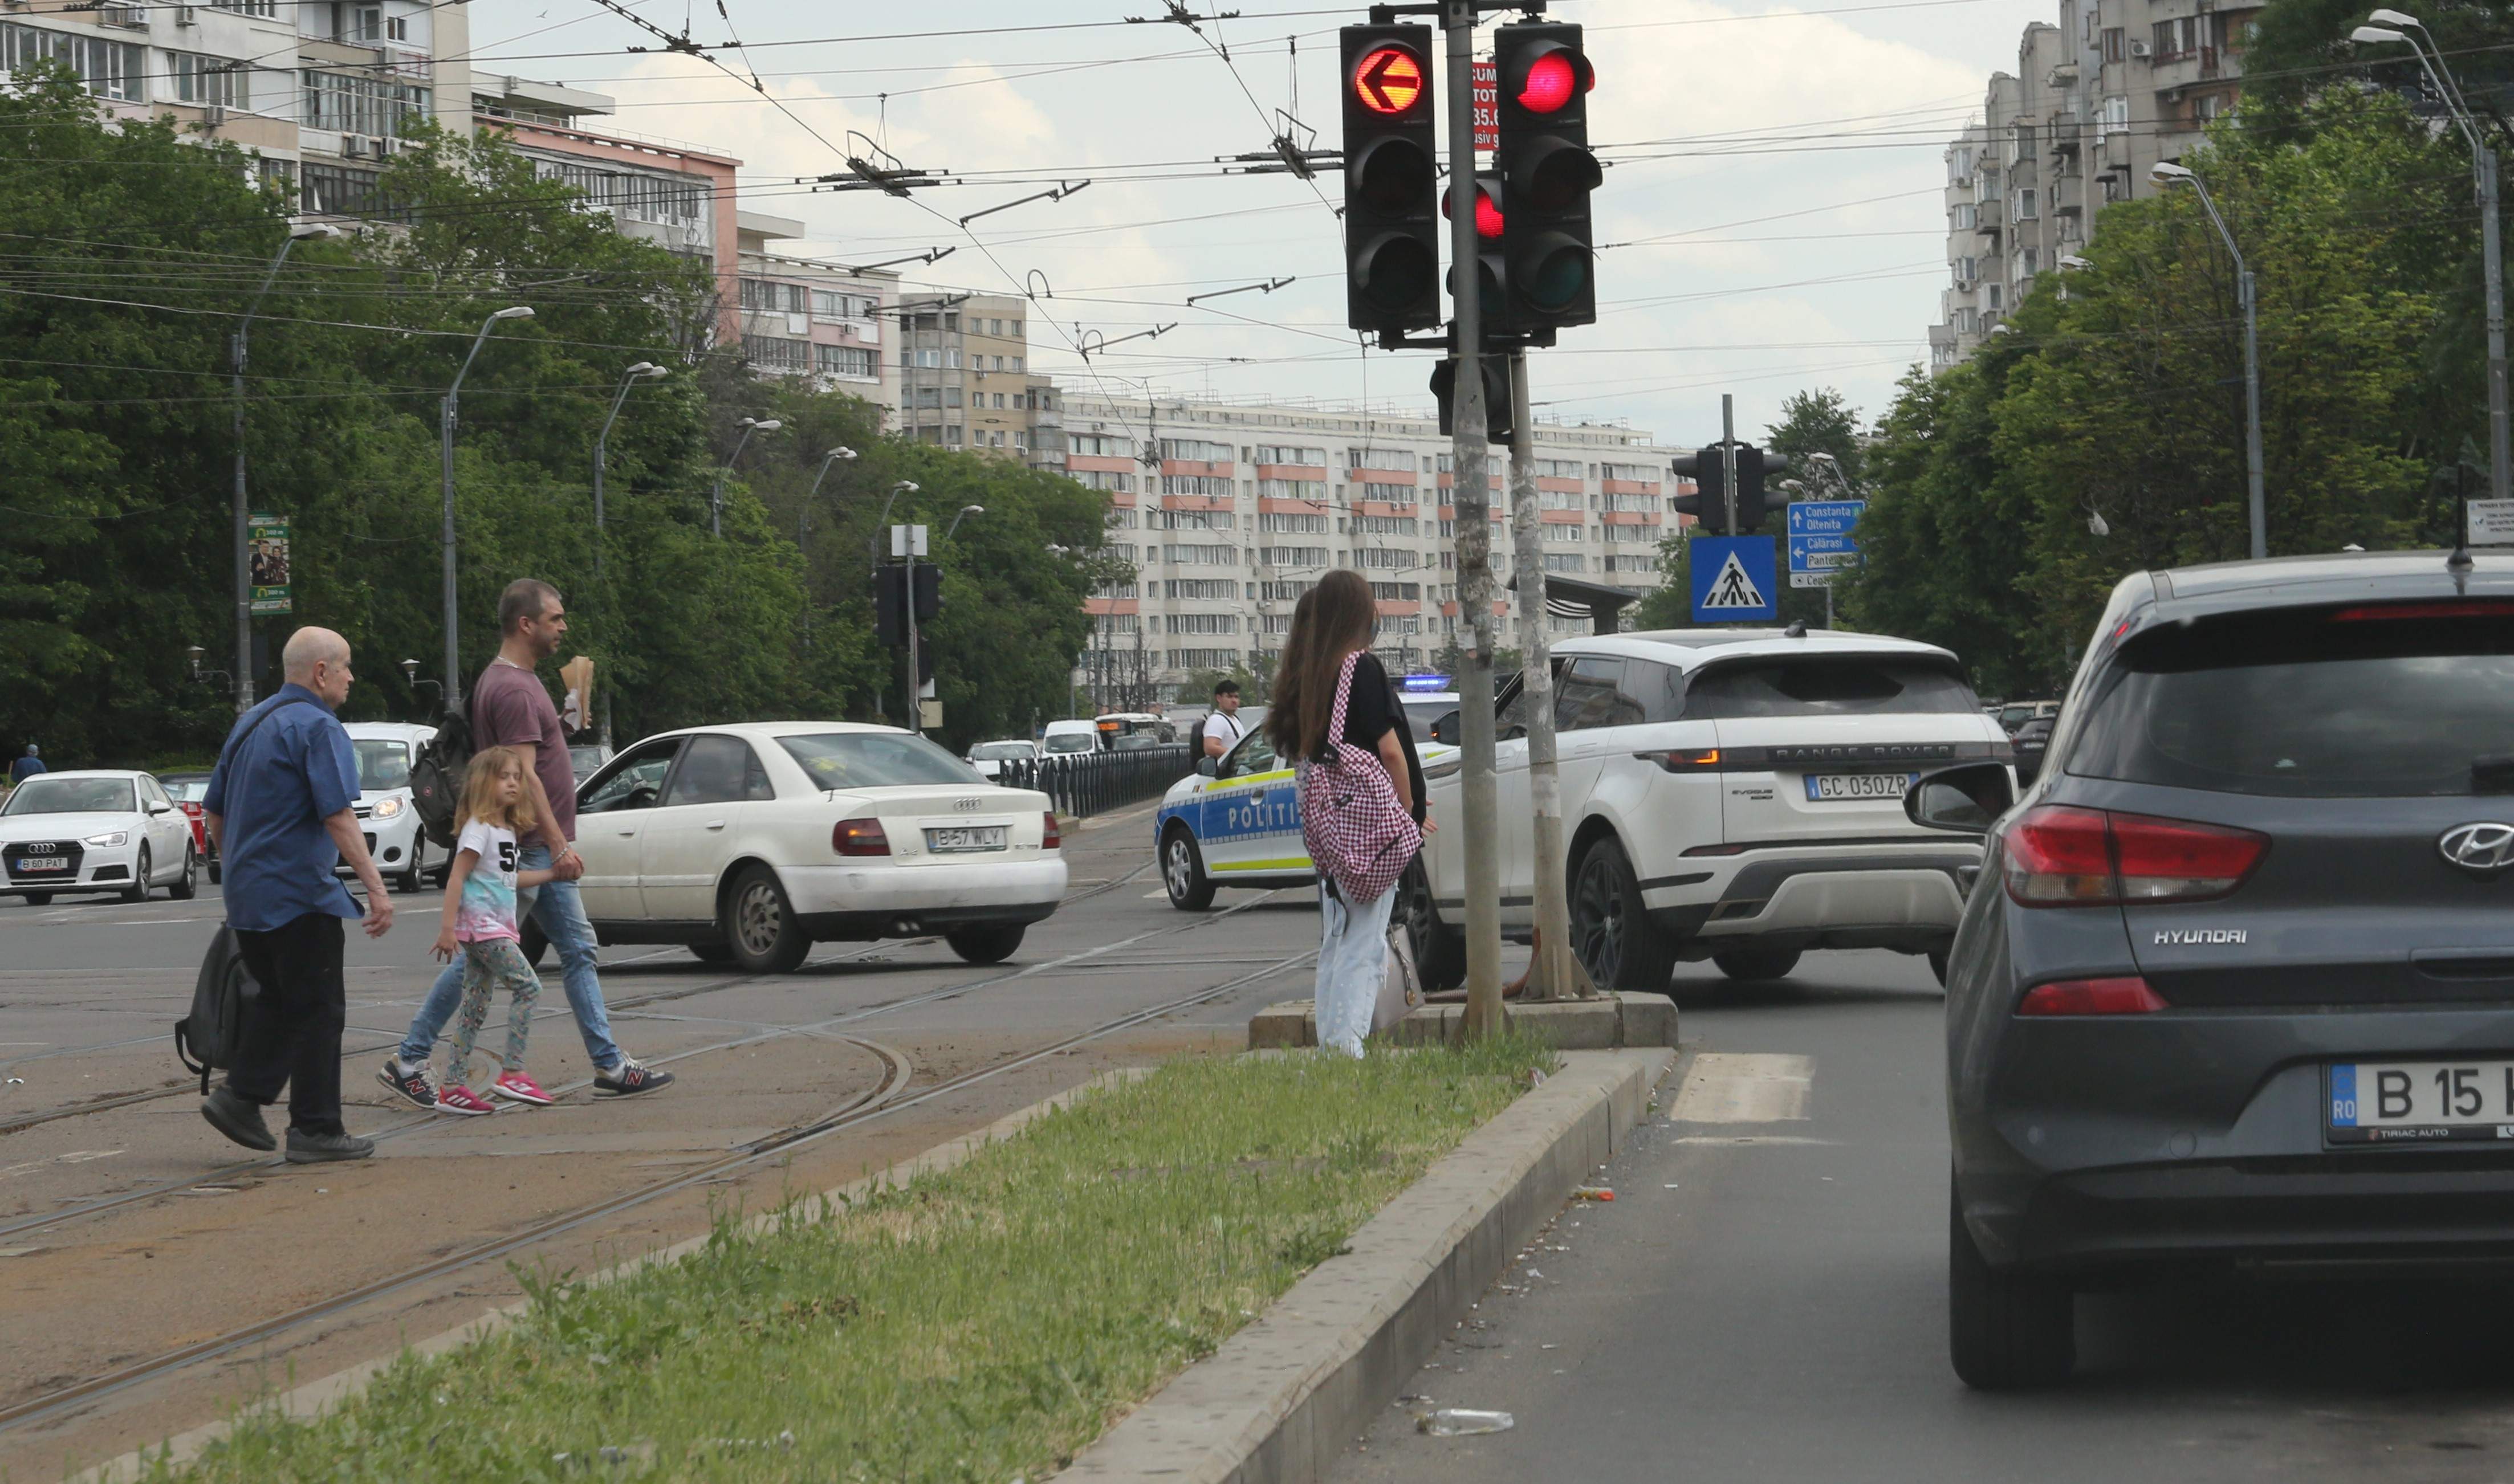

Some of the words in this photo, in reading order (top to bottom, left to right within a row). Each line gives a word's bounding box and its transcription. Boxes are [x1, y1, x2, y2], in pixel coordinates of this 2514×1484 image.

[1776, 747, 1858, 757] RANGE
[1874, 745, 1949, 756] ROVER
[1819, 777, 1843, 796] GC
[1849, 776, 1907, 796] 030ZR
[1228, 802, 1303, 829] POLITI
[23, 859, 30, 869] B
[32, 859, 43, 868] 60
[46, 858, 63, 867] PAT
[2154, 929, 2247, 944] HYUNDAI
[2333, 1100, 2355, 1119] RO
[2377, 1070, 2413, 1119] B
[2435, 1068, 2483, 1117] 15
[2381, 1129, 2417, 1138] TIRIAC
[2418, 1128, 2449, 1137] AUTO
